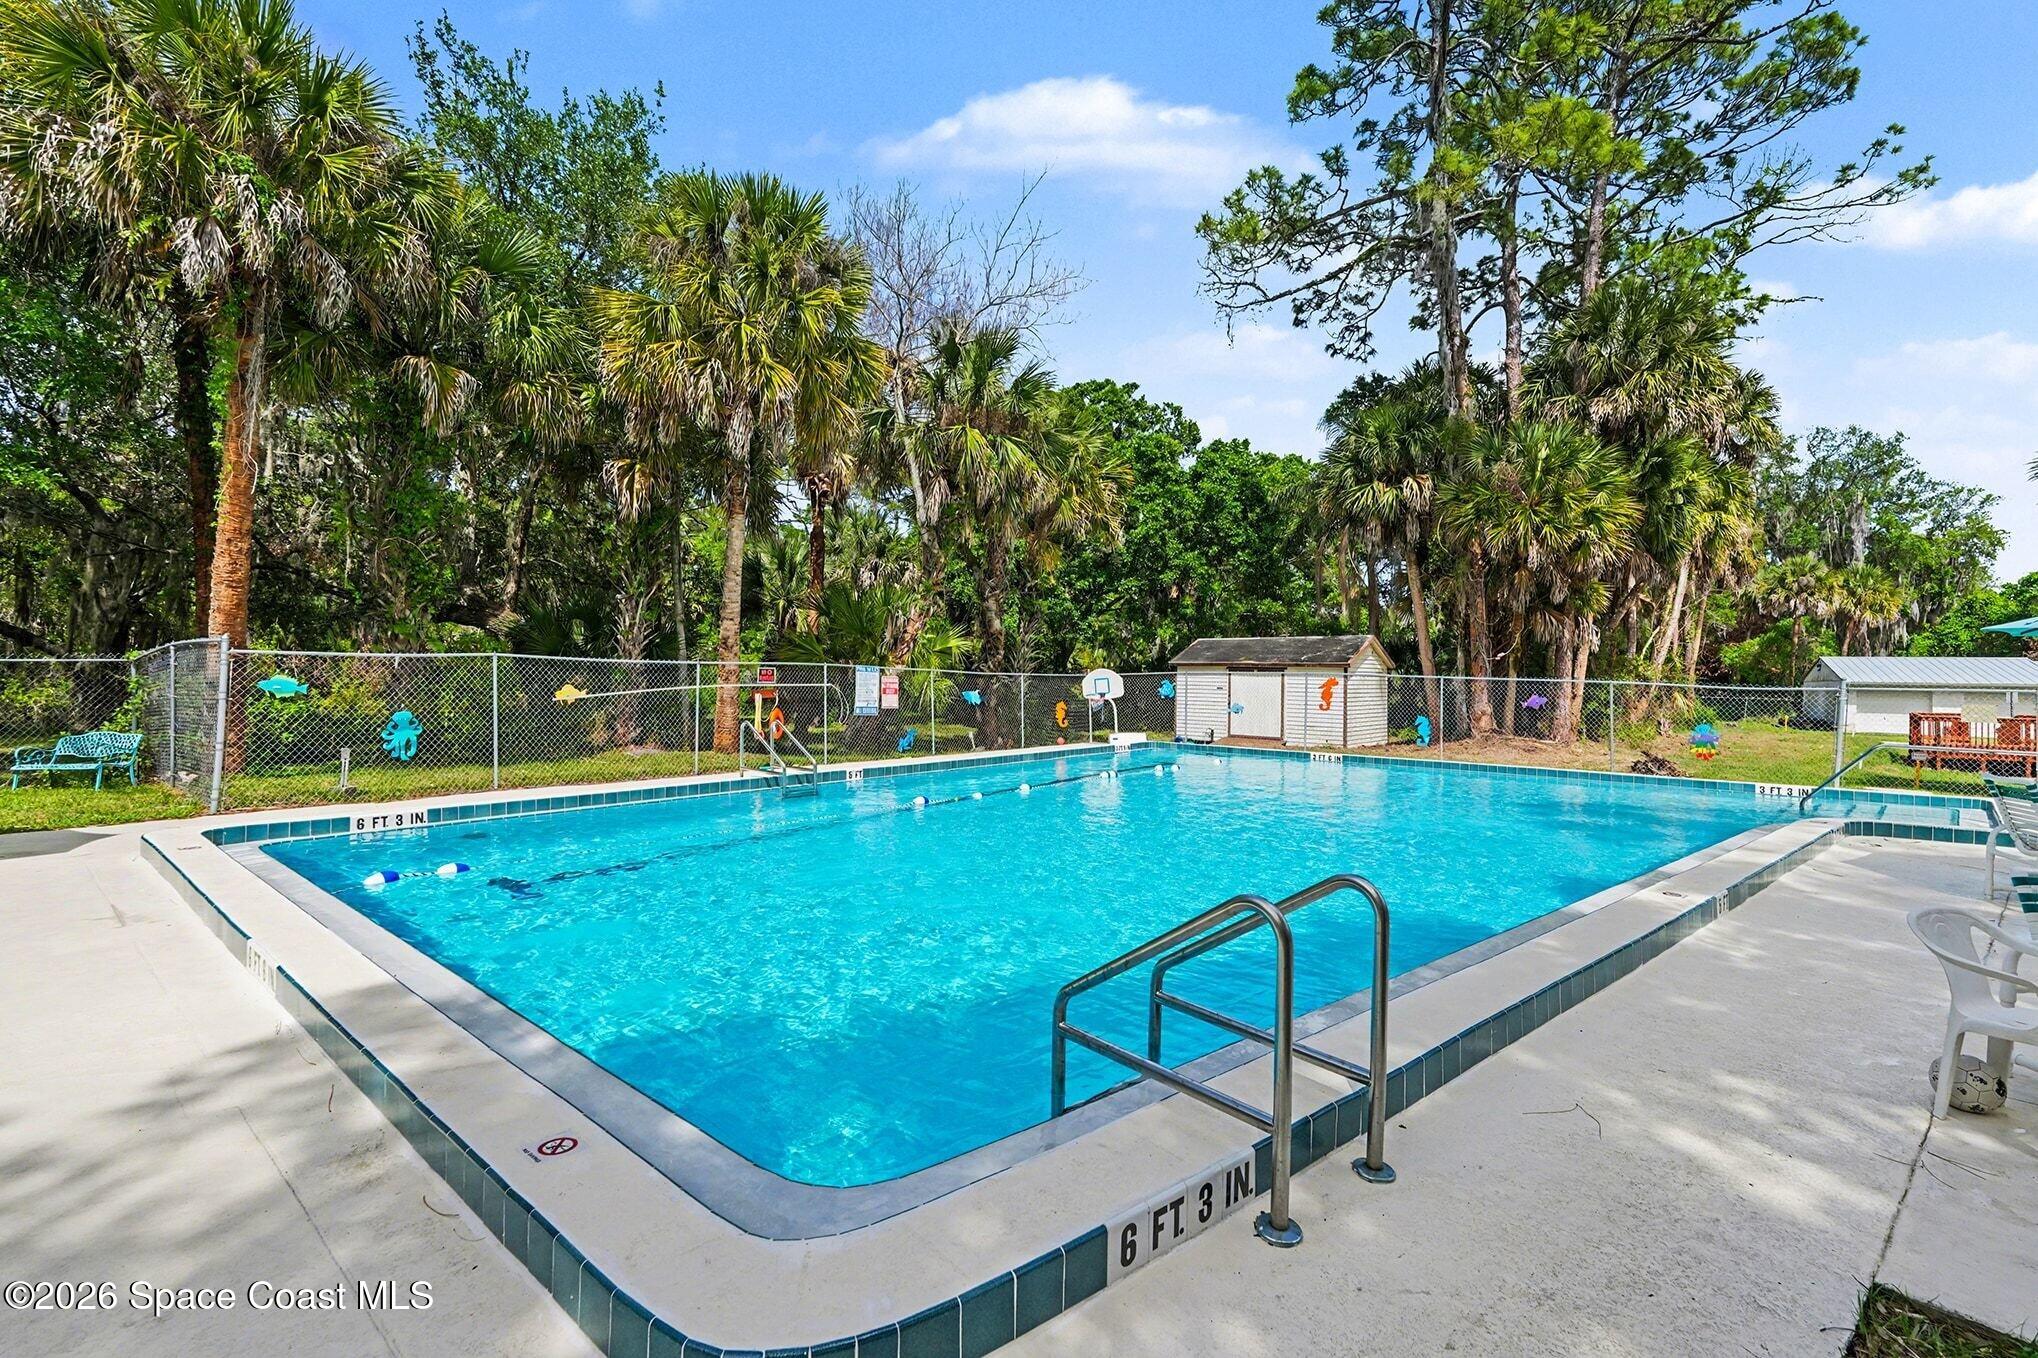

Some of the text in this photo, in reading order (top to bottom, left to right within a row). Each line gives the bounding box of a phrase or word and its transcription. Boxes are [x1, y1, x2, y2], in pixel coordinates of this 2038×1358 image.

[855, 770, 863, 779] FT
[1759, 785, 1809, 797] 3 FT 3 IN
[356, 811, 427, 831] 6 FT. 3 IN.
[1120, 1161, 1254, 1268] 6 FT. 3 IN.
